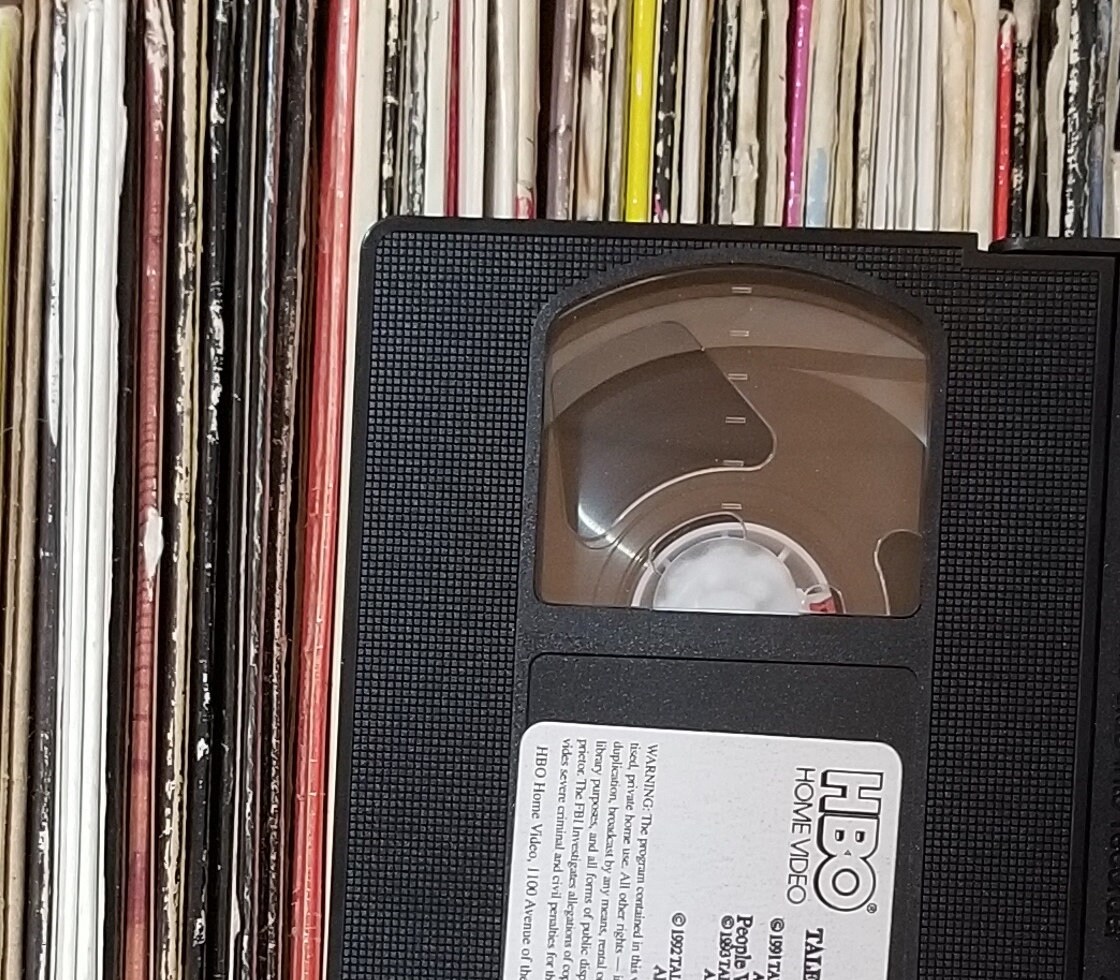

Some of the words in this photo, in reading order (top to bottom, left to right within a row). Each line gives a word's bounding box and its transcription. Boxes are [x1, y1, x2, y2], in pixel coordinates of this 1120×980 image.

[534, 745, 549, 779] HBO
[560, 738, 574, 767] vides
[590, 740, 608, 776] library
[557, 768, 568, 804] severe
[574, 778, 588, 800] The
[607, 740, 625, 804] duplication,
[641, 744, 659, 812] WARNING:
[531, 781, 546, 820] Home
[624, 773, 639, 811] private
[791, 767, 815, 833] HOME
[554, 805, 568, 851] criminal
[572, 802, 586, 824] FBI
[622, 814, 636, 845] home
[639, 813, 653, 836] The
[526, 823, 543, 863] Video,
[587, 832, 600, 853] and
[604, 806, 620, 858] broadcast
[812, 769, 883, 912] HBO
[552, 852, 565, 873] and
[566, 826, 584, 889] Investigates
[586, 855, 599, 869] all
[635, 838, 648, 884] program
[786, 838, 810, 904] VIDEO
[525, 867, 540, 897] 1100
[550, 874, 563, 899] civil
[584, 872, 598, 904] forms
[599, 876, 612, 897] any
[619, 871, 631, 889] All
[521, 898, 537, 945] Avenue
[563, 890, 579, 948] allegations
[617, 892, 630, 921] other
[632, 886, 646, 939] contained
[546, 901, 560, 949] penalties
[578, 921, 593, 956] public
[613, 923, 628, 954] rights
[669, 928, 685, 956] 1992
[729, 914, 754, 970] People
[545, 951, 558, 969] for
[629, 954, 642, 975] this
[767, 934, 784, 961] 1991
